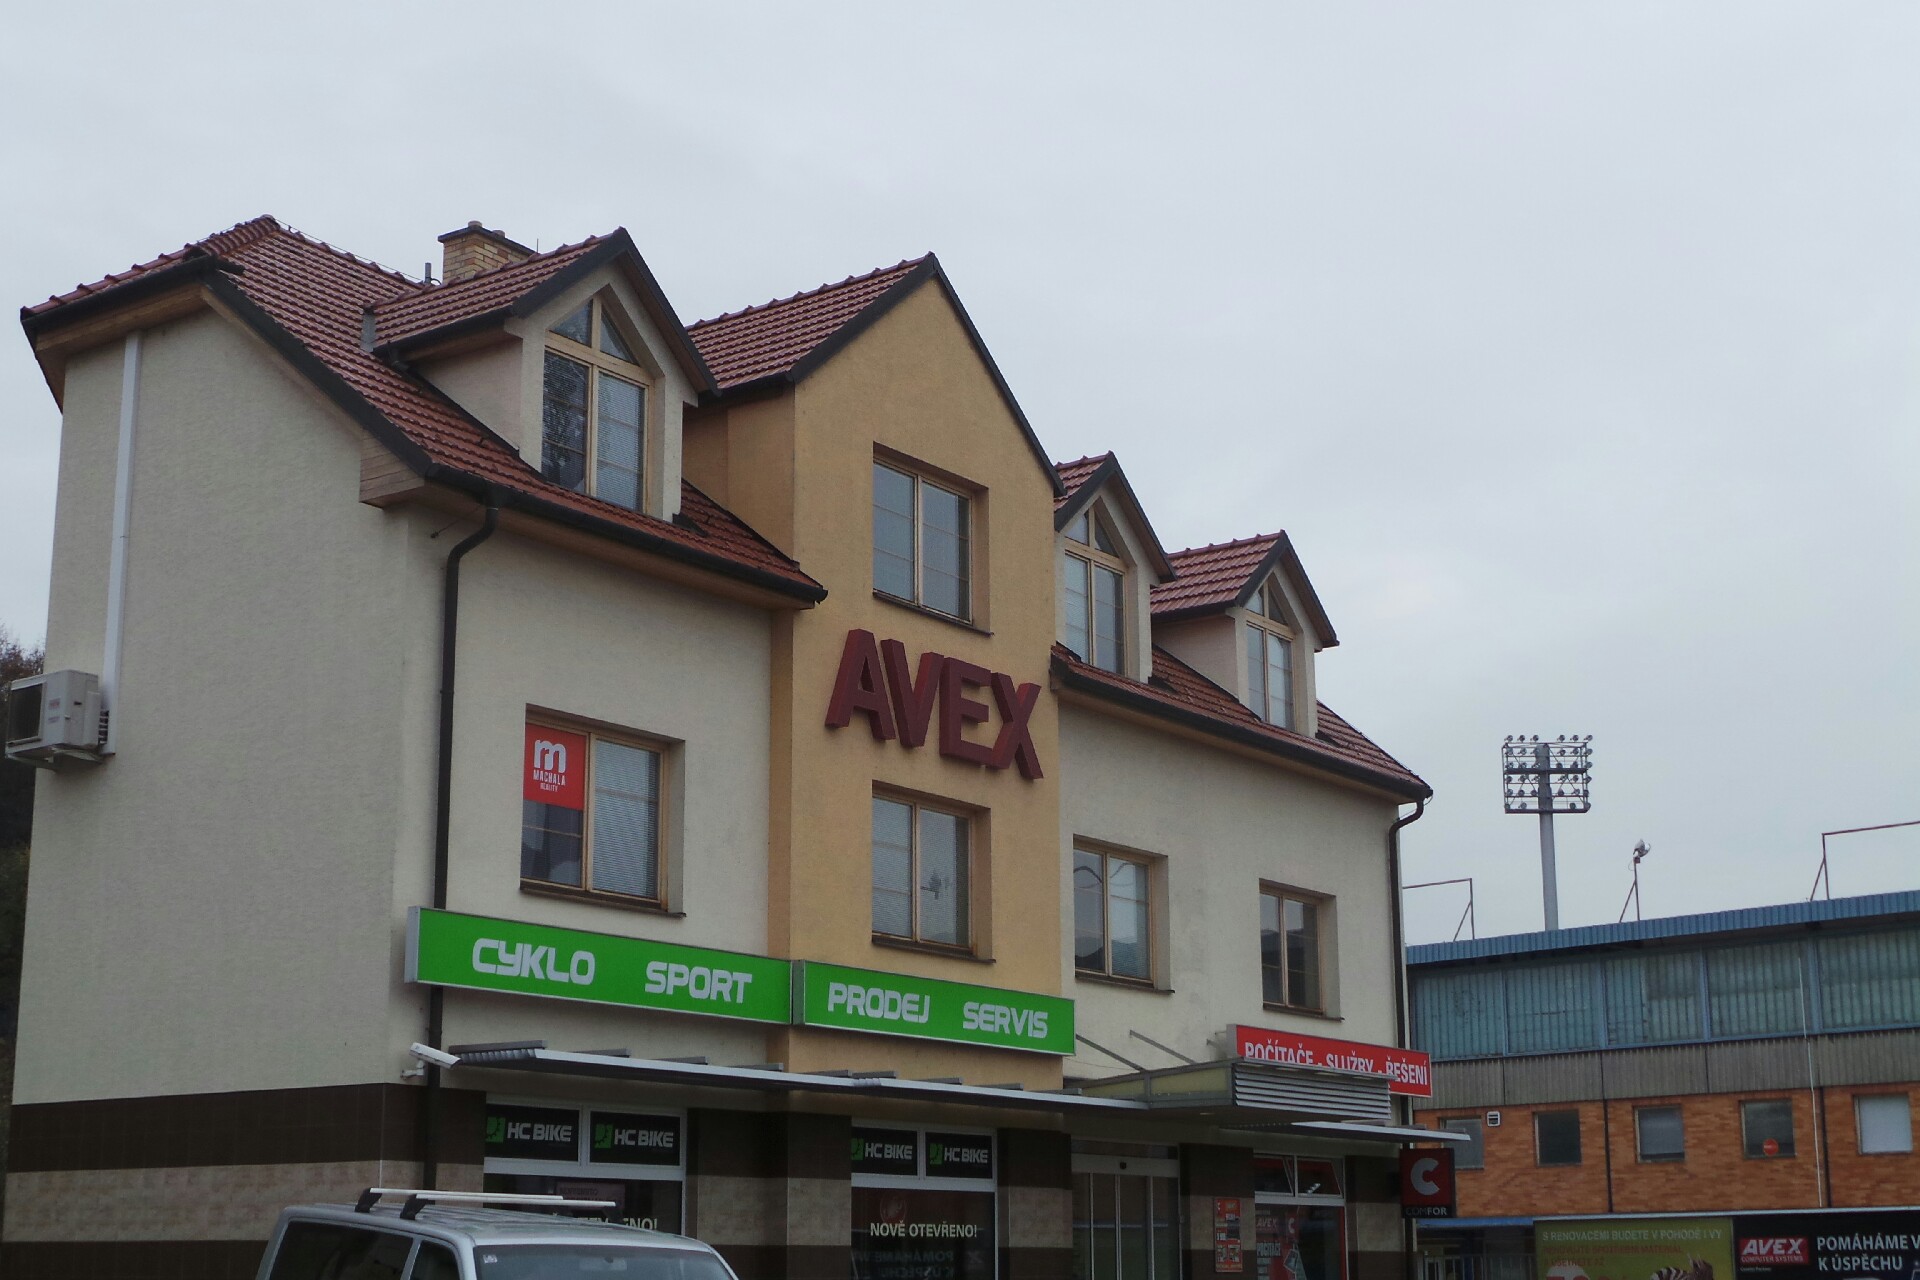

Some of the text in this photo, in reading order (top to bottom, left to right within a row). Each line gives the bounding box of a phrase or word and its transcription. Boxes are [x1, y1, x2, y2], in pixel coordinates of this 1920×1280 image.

[825, 629, 1043, 779] AVEX
[533, 769, 566, 786] MACHALA
[472, 937, 753, 1004] CYKLO SPORT
[827, 981, 1048, 1038] PRODEJ SERVIS
[1245, 1038, 1313, 1065] POČÍTAČE
[1386, 1055, 1428, 1086] ŘEŠENÍ
[507, 1121, 572, 1143] HC BIKE
[614, 1128, 674, 1148] HC BIKE
[865, 1142, 913, 1160] HC BIKE
[944, 1147, 989, 1164] HC BIKE
[1406, 1206, 1448, 1216] COMFOR
[870, 1219, 977, 1238] NOVĚ OTEVŘENO!
[1742, 1238, 1804, 1256] AVEX
[1816, 1232, 1909, 1251] POMÁHÁME
[1741, 1254, 1804, 1263] COMPUTER SYSTEMS
[1818, 1252, 1903, 1272] K ÚSPĚCHU
